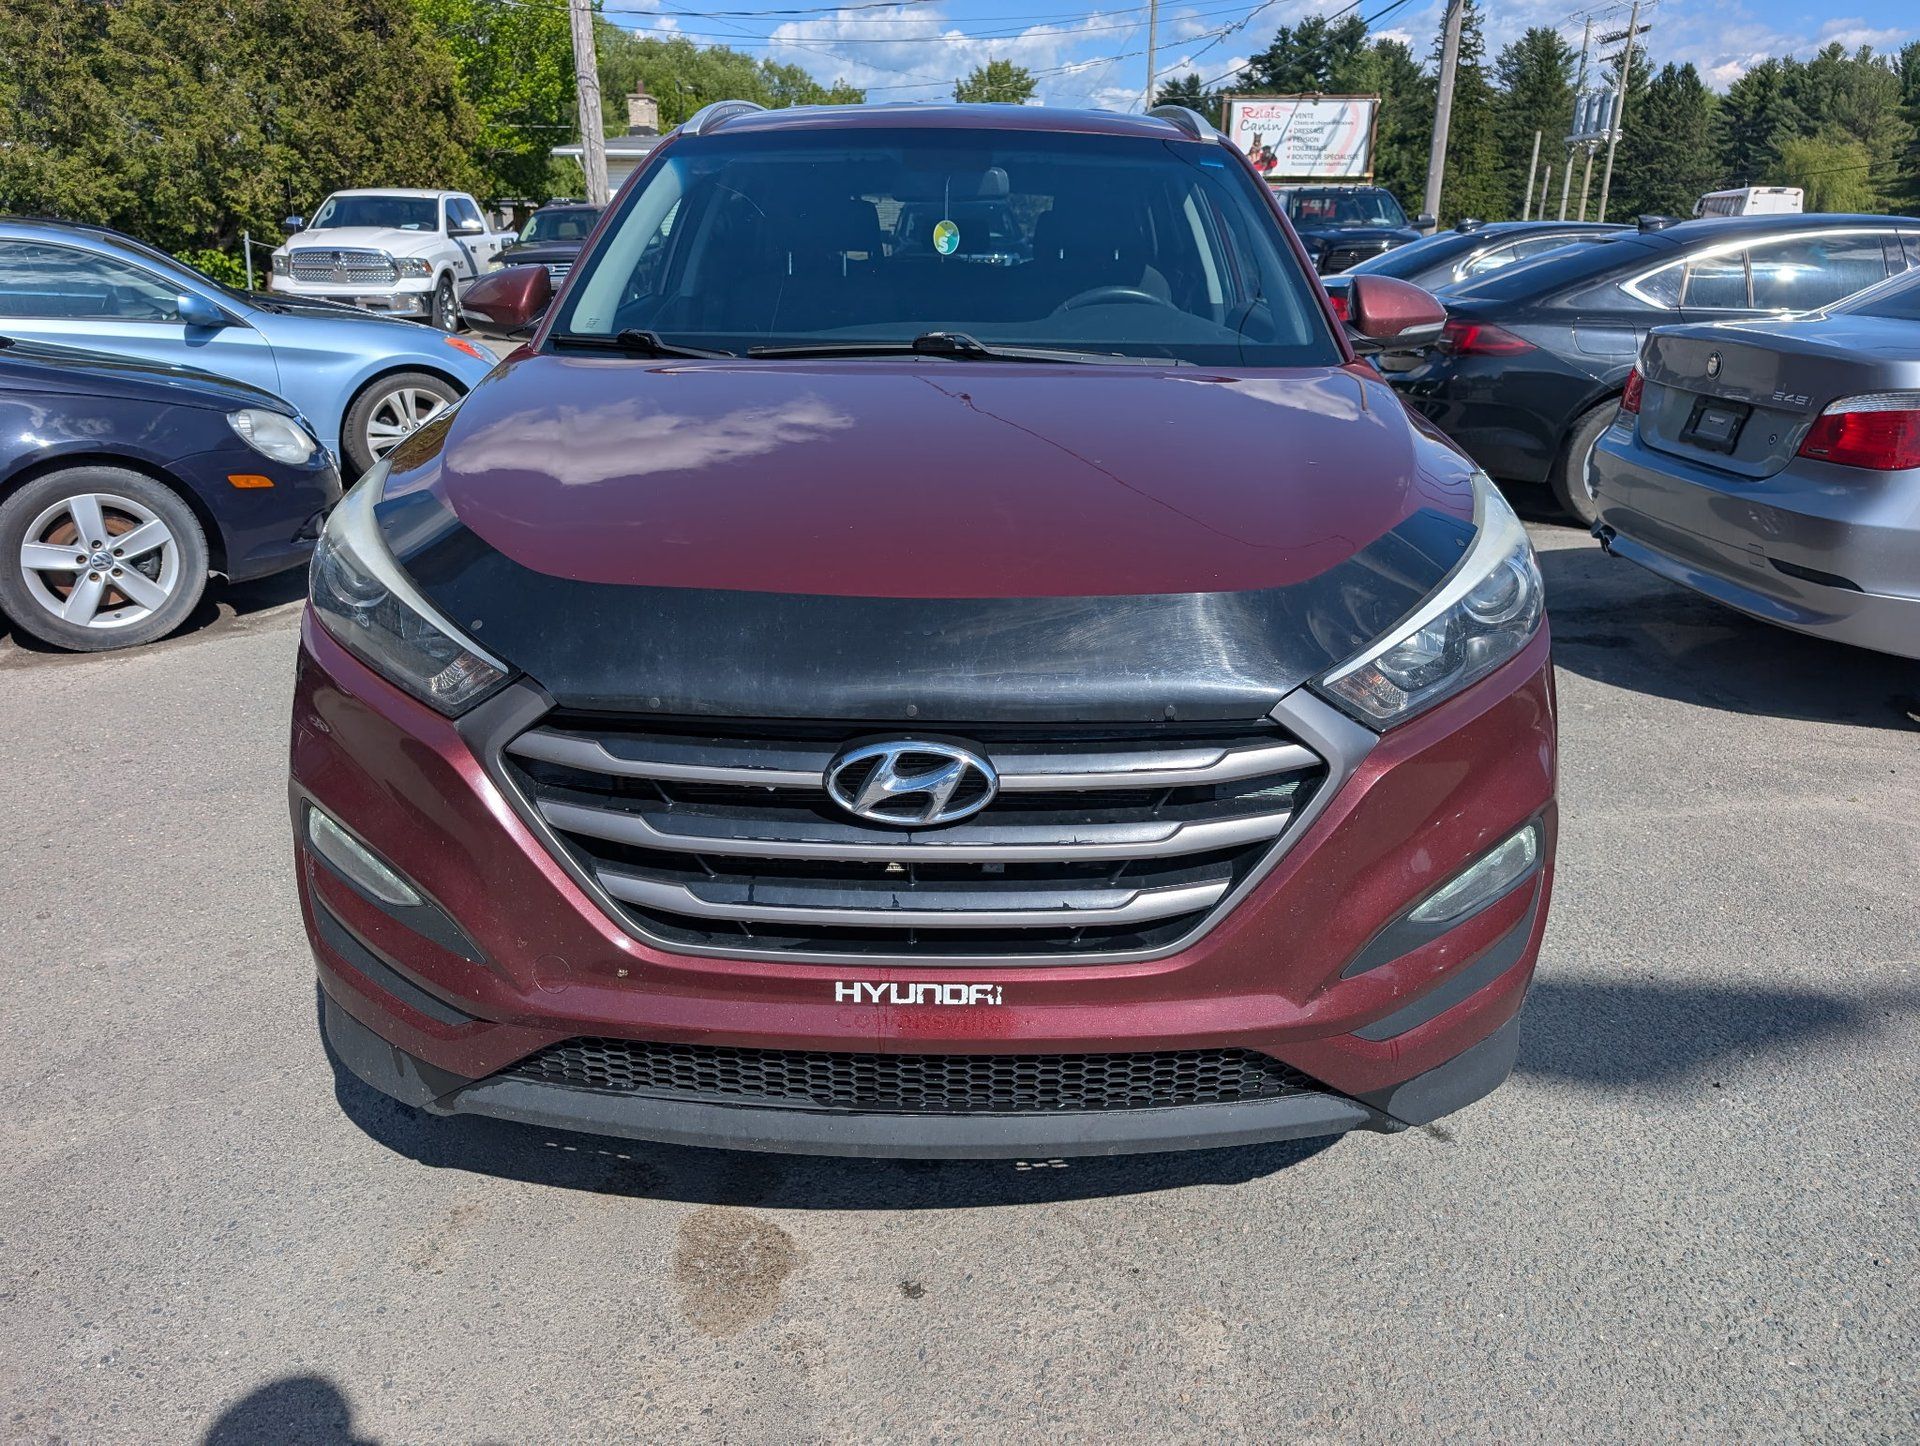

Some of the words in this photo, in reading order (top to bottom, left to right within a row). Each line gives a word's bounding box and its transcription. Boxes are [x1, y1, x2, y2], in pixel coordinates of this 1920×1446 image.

[1241, 106, 1281, 119] Relais
[1240, 119, 1282, 131] Canin
[835, 981, 1003, 1005] HYUNDAI
